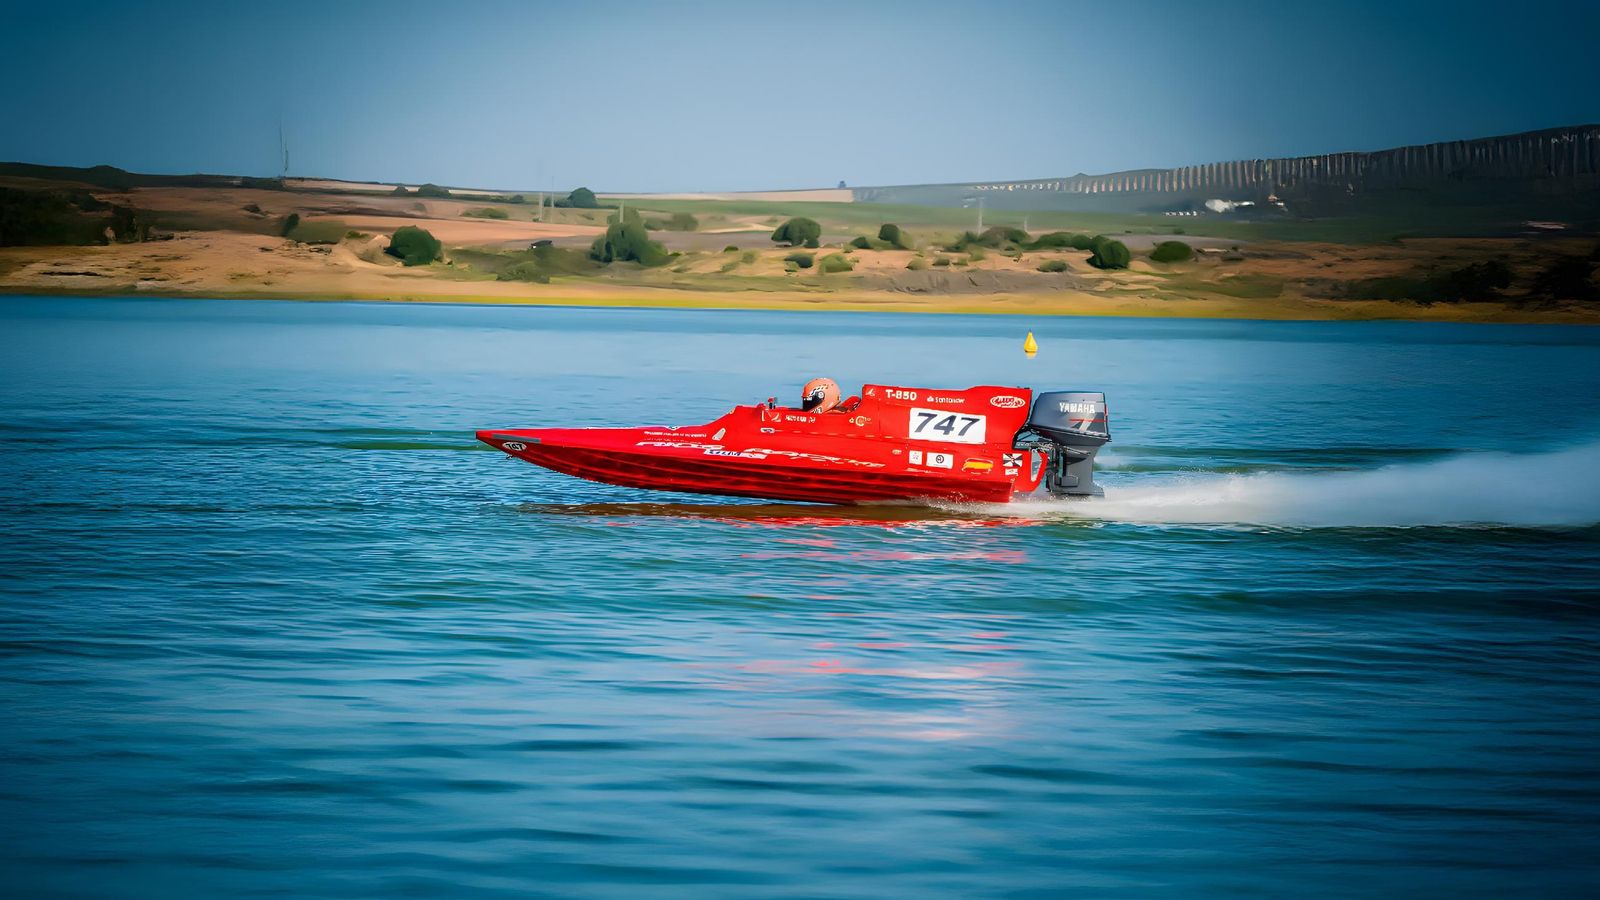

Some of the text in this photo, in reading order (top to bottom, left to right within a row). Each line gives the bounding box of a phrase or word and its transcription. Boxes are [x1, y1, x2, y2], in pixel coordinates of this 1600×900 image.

[885, 389, 917, 401] T-850
[1059, 402, 1095, 414] YAMAHA
[914, 412, 981, 437] 747
